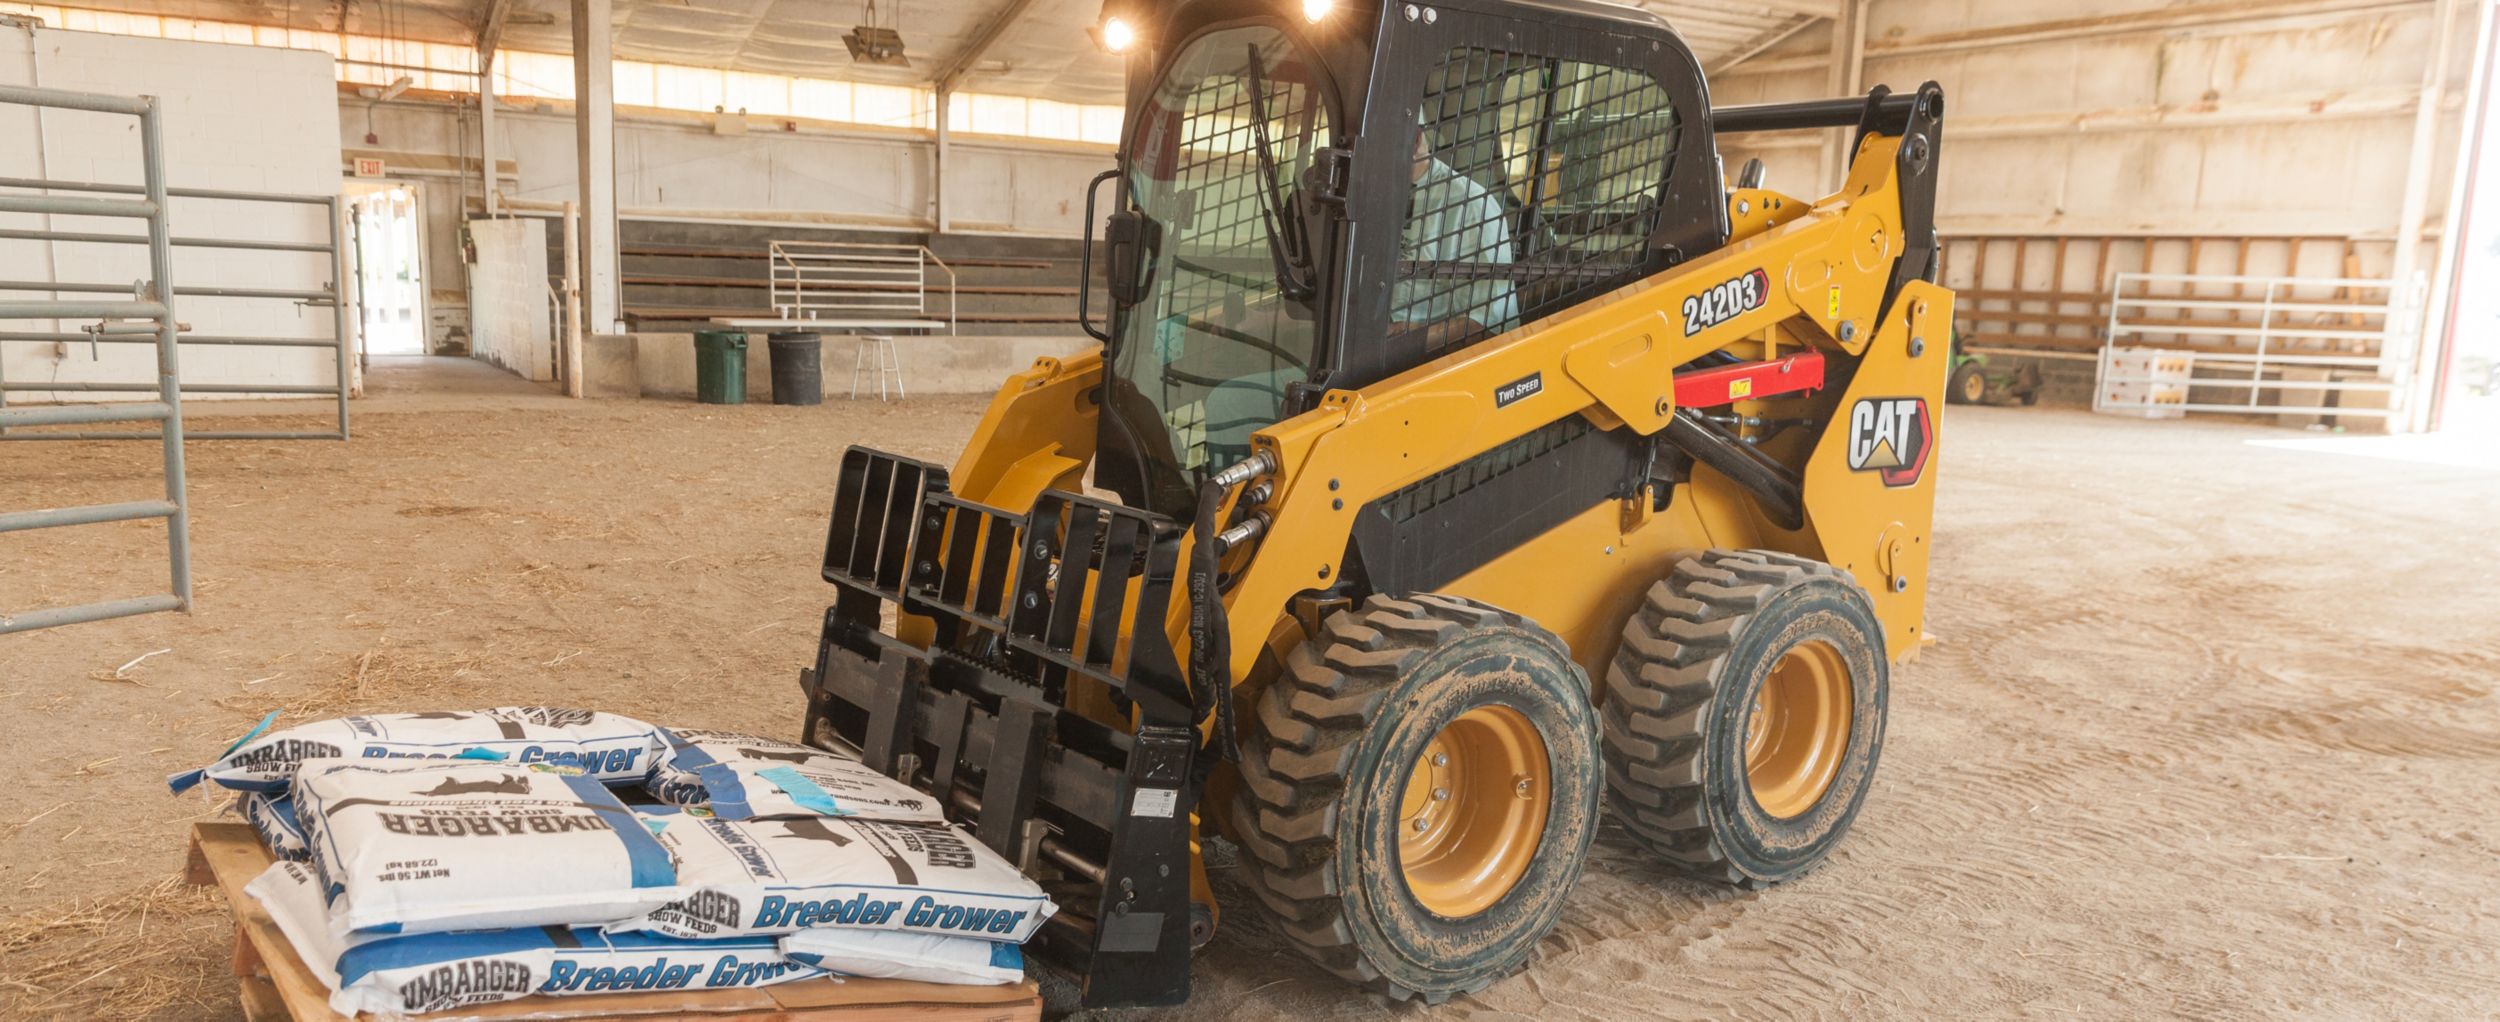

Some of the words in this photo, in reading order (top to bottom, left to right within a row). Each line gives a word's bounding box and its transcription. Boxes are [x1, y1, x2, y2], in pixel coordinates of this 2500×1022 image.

[360, 160, 381, 175] EXIT
[1683, 273, 1757, 336] 242D3
[1849, 400, 1917, 469] CAT
[376, 811, 616, 837] UMBARGER
[397, 871, 411, 881] 50
[433, 868, 451, 878] Net
[684, 916, 718, 934] FEEDS
[751, 893, 902, 929] Breeder
[903, 895, 1028, 934] Grower
[399, 960, 532, 1010] UMBARGER
[540, 957, 705, 992] Breeder
[466, 993, 505, 1002] FEEDS
